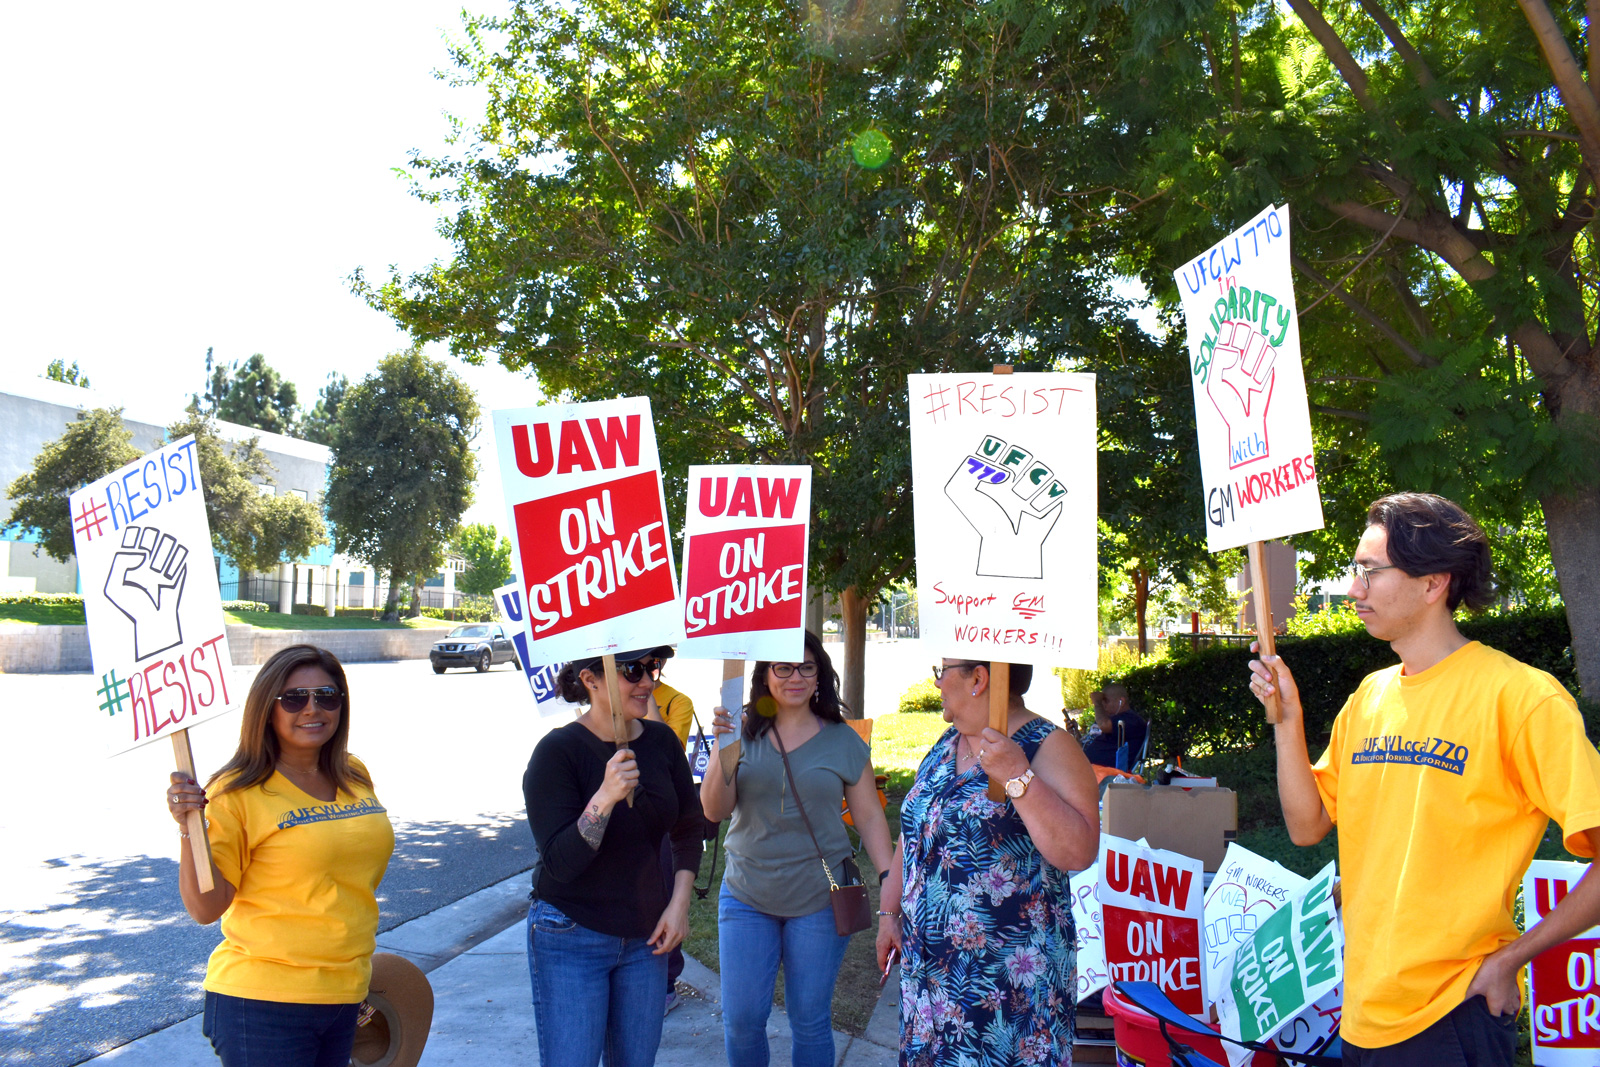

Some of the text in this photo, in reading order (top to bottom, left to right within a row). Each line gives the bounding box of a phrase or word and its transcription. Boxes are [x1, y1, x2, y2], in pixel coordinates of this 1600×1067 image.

[1182, 211, 1282, 294] UFCW 770
[1217, 273, 1237, 295] in
[1194, 286, 1290, 384] SOLIDARITY
[923, 381, 1083, 424] #RESIST
[511, 414, 641, 478] UAW
[1231, 432, 1266, 464] With
[74, 440, 198, 541] #RESIST
[967, 457, 1006, 483] 770
[1208, 453, 1315, 527] GM WORKERS
[698, 476, 802, 519] UAW
[559, 489, 616, 555] ON
[528, 521, 667, 634] STRIKE
[719, 532, 766, 579] ON
[686, 563, 803, 634] STRIKE
[933, 581, 1046, 614] Support GM
[97, 634, 230, 742] #RESIST
[1430, 737, 1469, 762] 770
[290, 804, 337, 819] UFCW
[336, 799, 368, 813] Local
[1105, 848, 1193, 911] UAW
[1225, 861, 1289, 902] GM WORKERS
[1126, 918, 1163, 957] ON
[1299, 877, 1337, 988] UAW
[1261, 936, 1294, 983] ON
